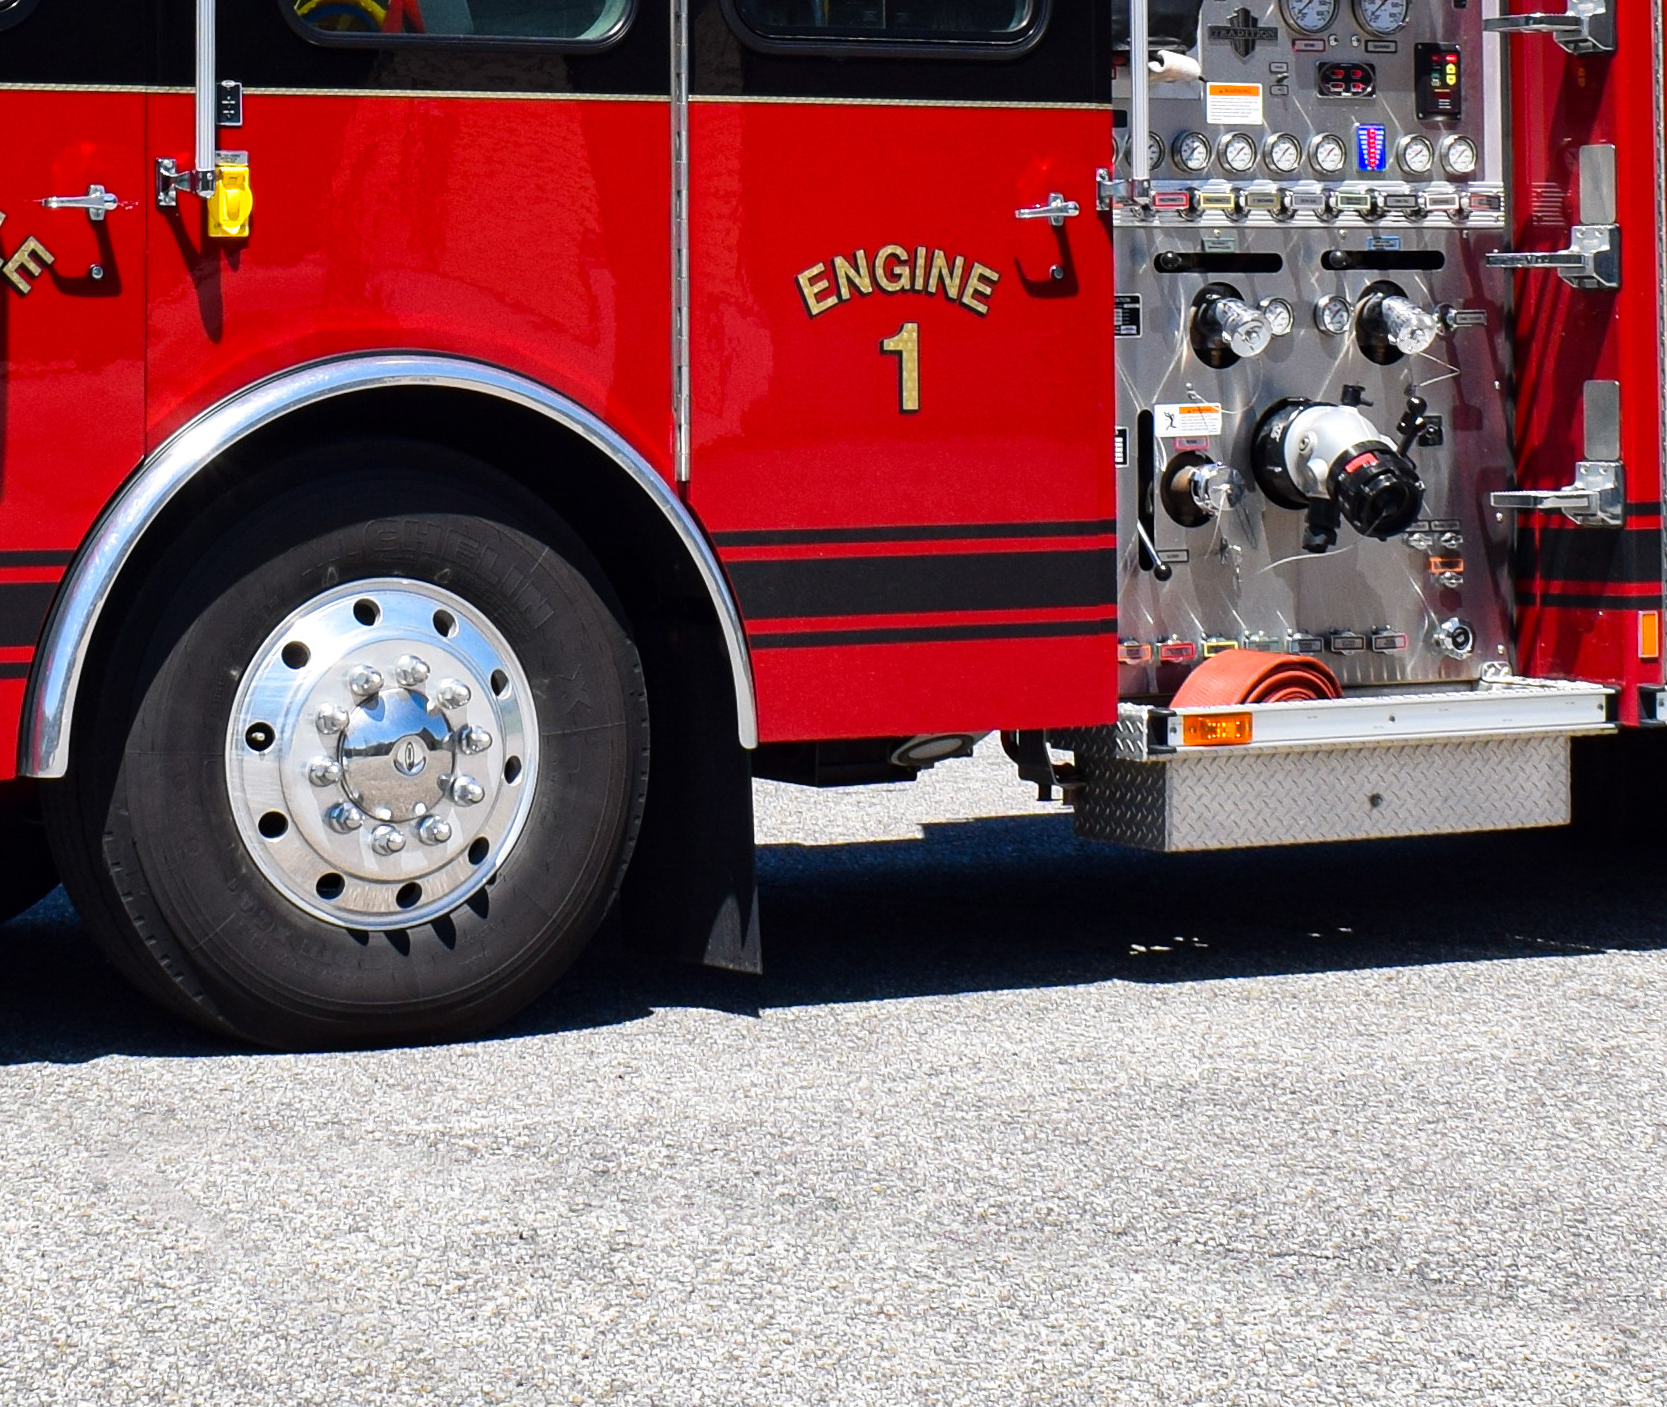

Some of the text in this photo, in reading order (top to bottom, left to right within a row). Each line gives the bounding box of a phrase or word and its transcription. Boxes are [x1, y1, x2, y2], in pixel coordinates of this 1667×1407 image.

[1211, 28, 1275, 38] TRADITION
[795, 244, 1000, 318] ENGINE
[879, 321, 920, 414] 1
